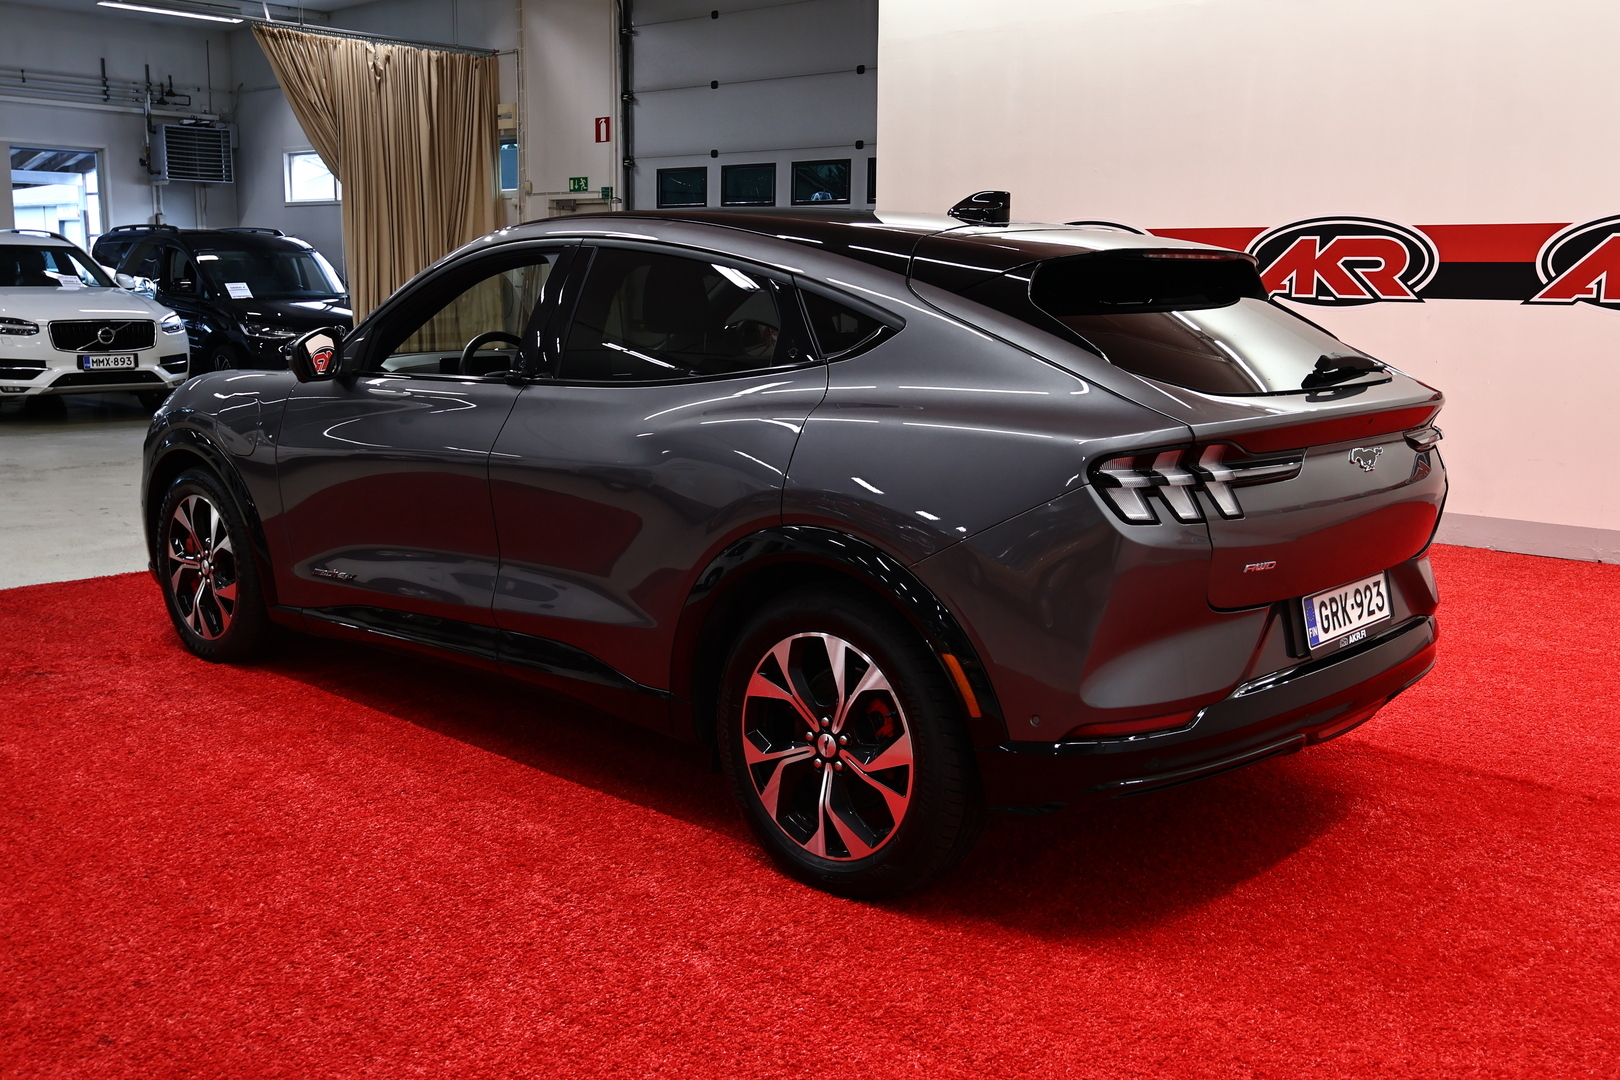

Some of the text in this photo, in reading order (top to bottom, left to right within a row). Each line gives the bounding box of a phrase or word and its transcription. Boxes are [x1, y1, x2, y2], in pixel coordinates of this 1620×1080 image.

[1259, 235, 1419, 300] AKR
[91, 357, 133, 367] MMX-893
[1319, 580, 1385, 634] GRK-923
[1309, 626, 1319, 638] FIN
